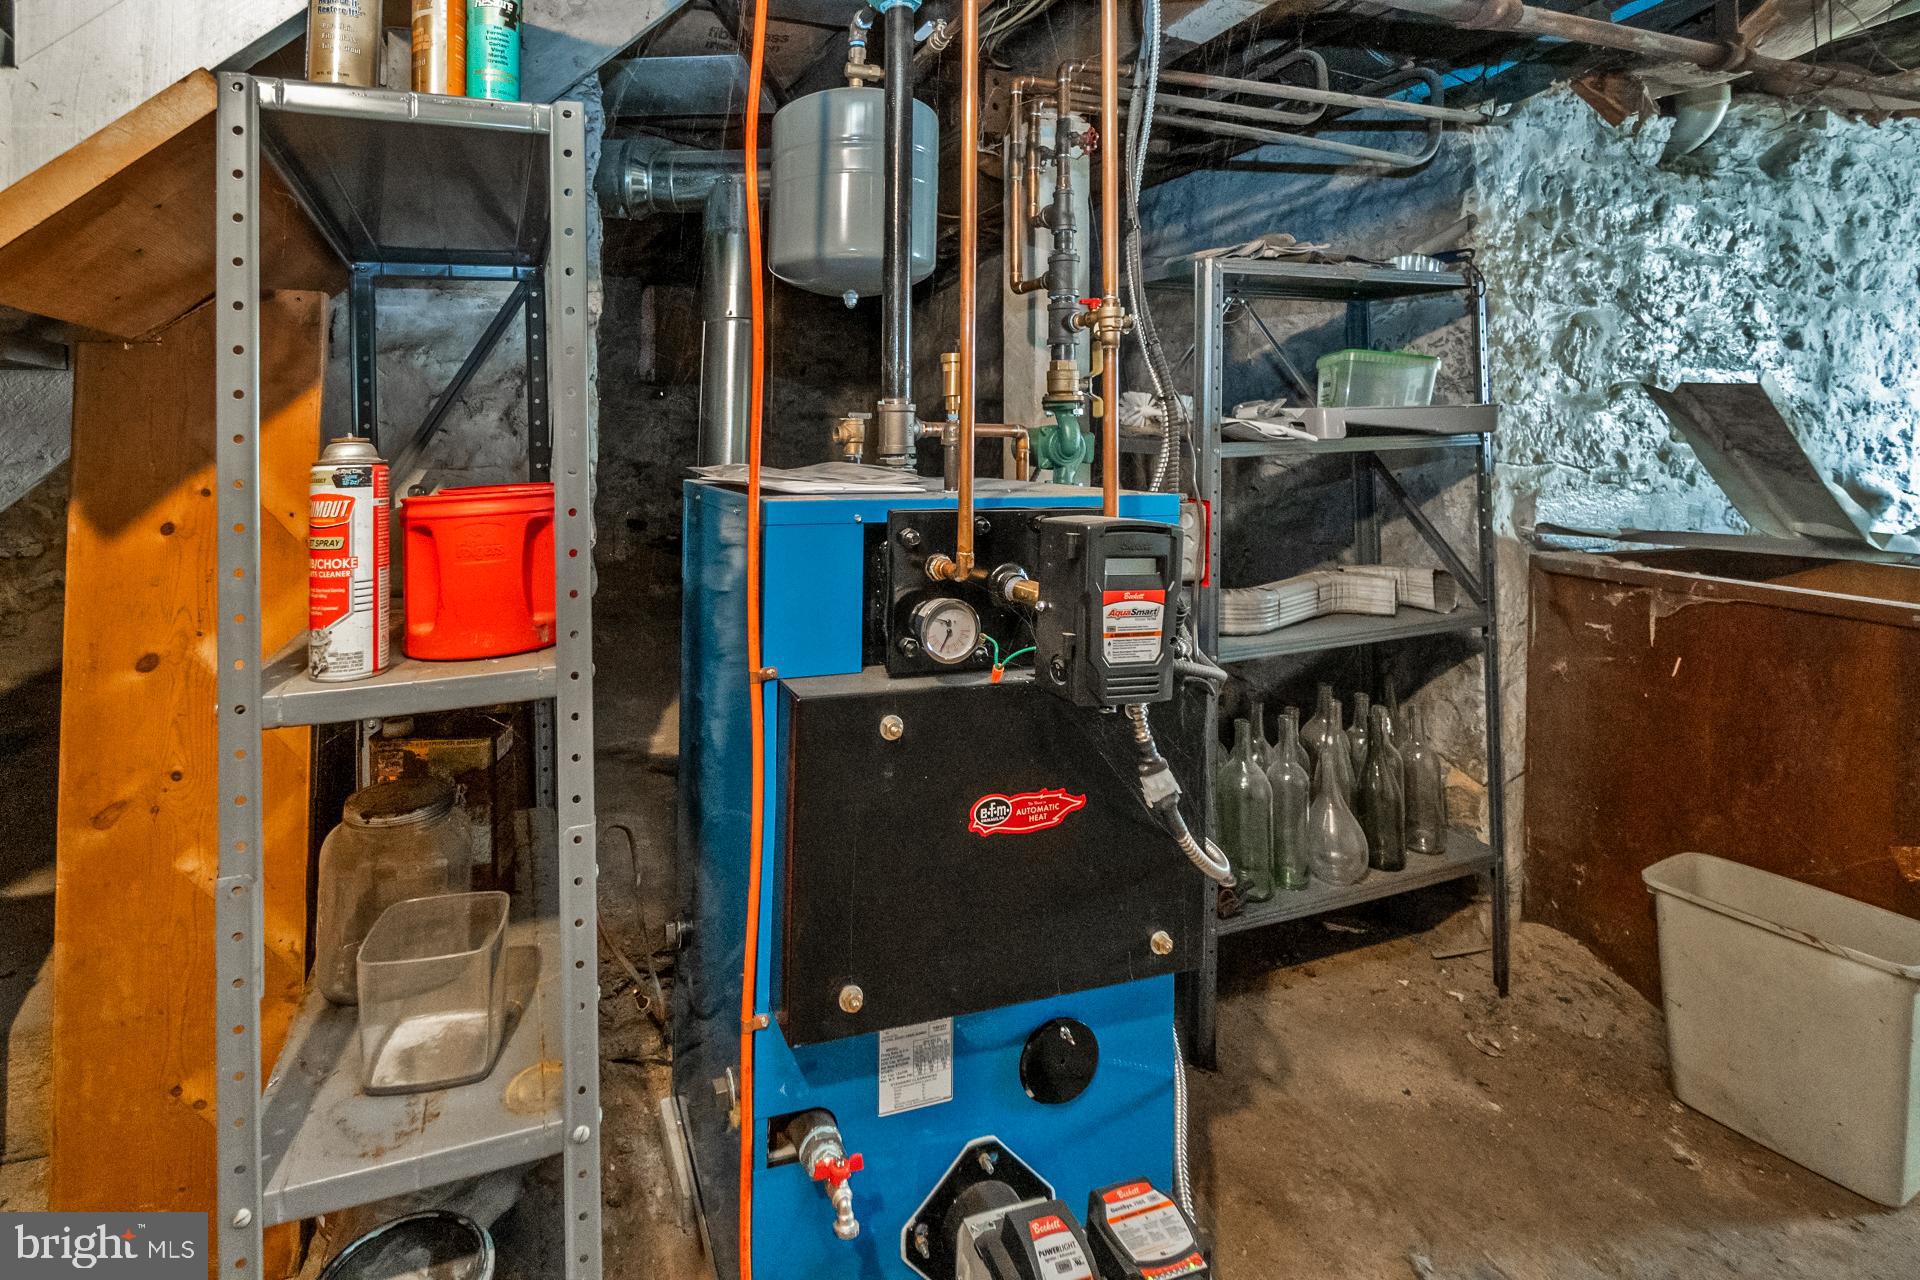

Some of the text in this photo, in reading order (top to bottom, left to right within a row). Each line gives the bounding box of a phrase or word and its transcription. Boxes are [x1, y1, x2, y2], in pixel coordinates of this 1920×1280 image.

[315, 539, 340, 548] SPRAY
[1016, 803, 1060, 816] AUTOMATIC
[1028, 813, 1048, 823] HEAT
